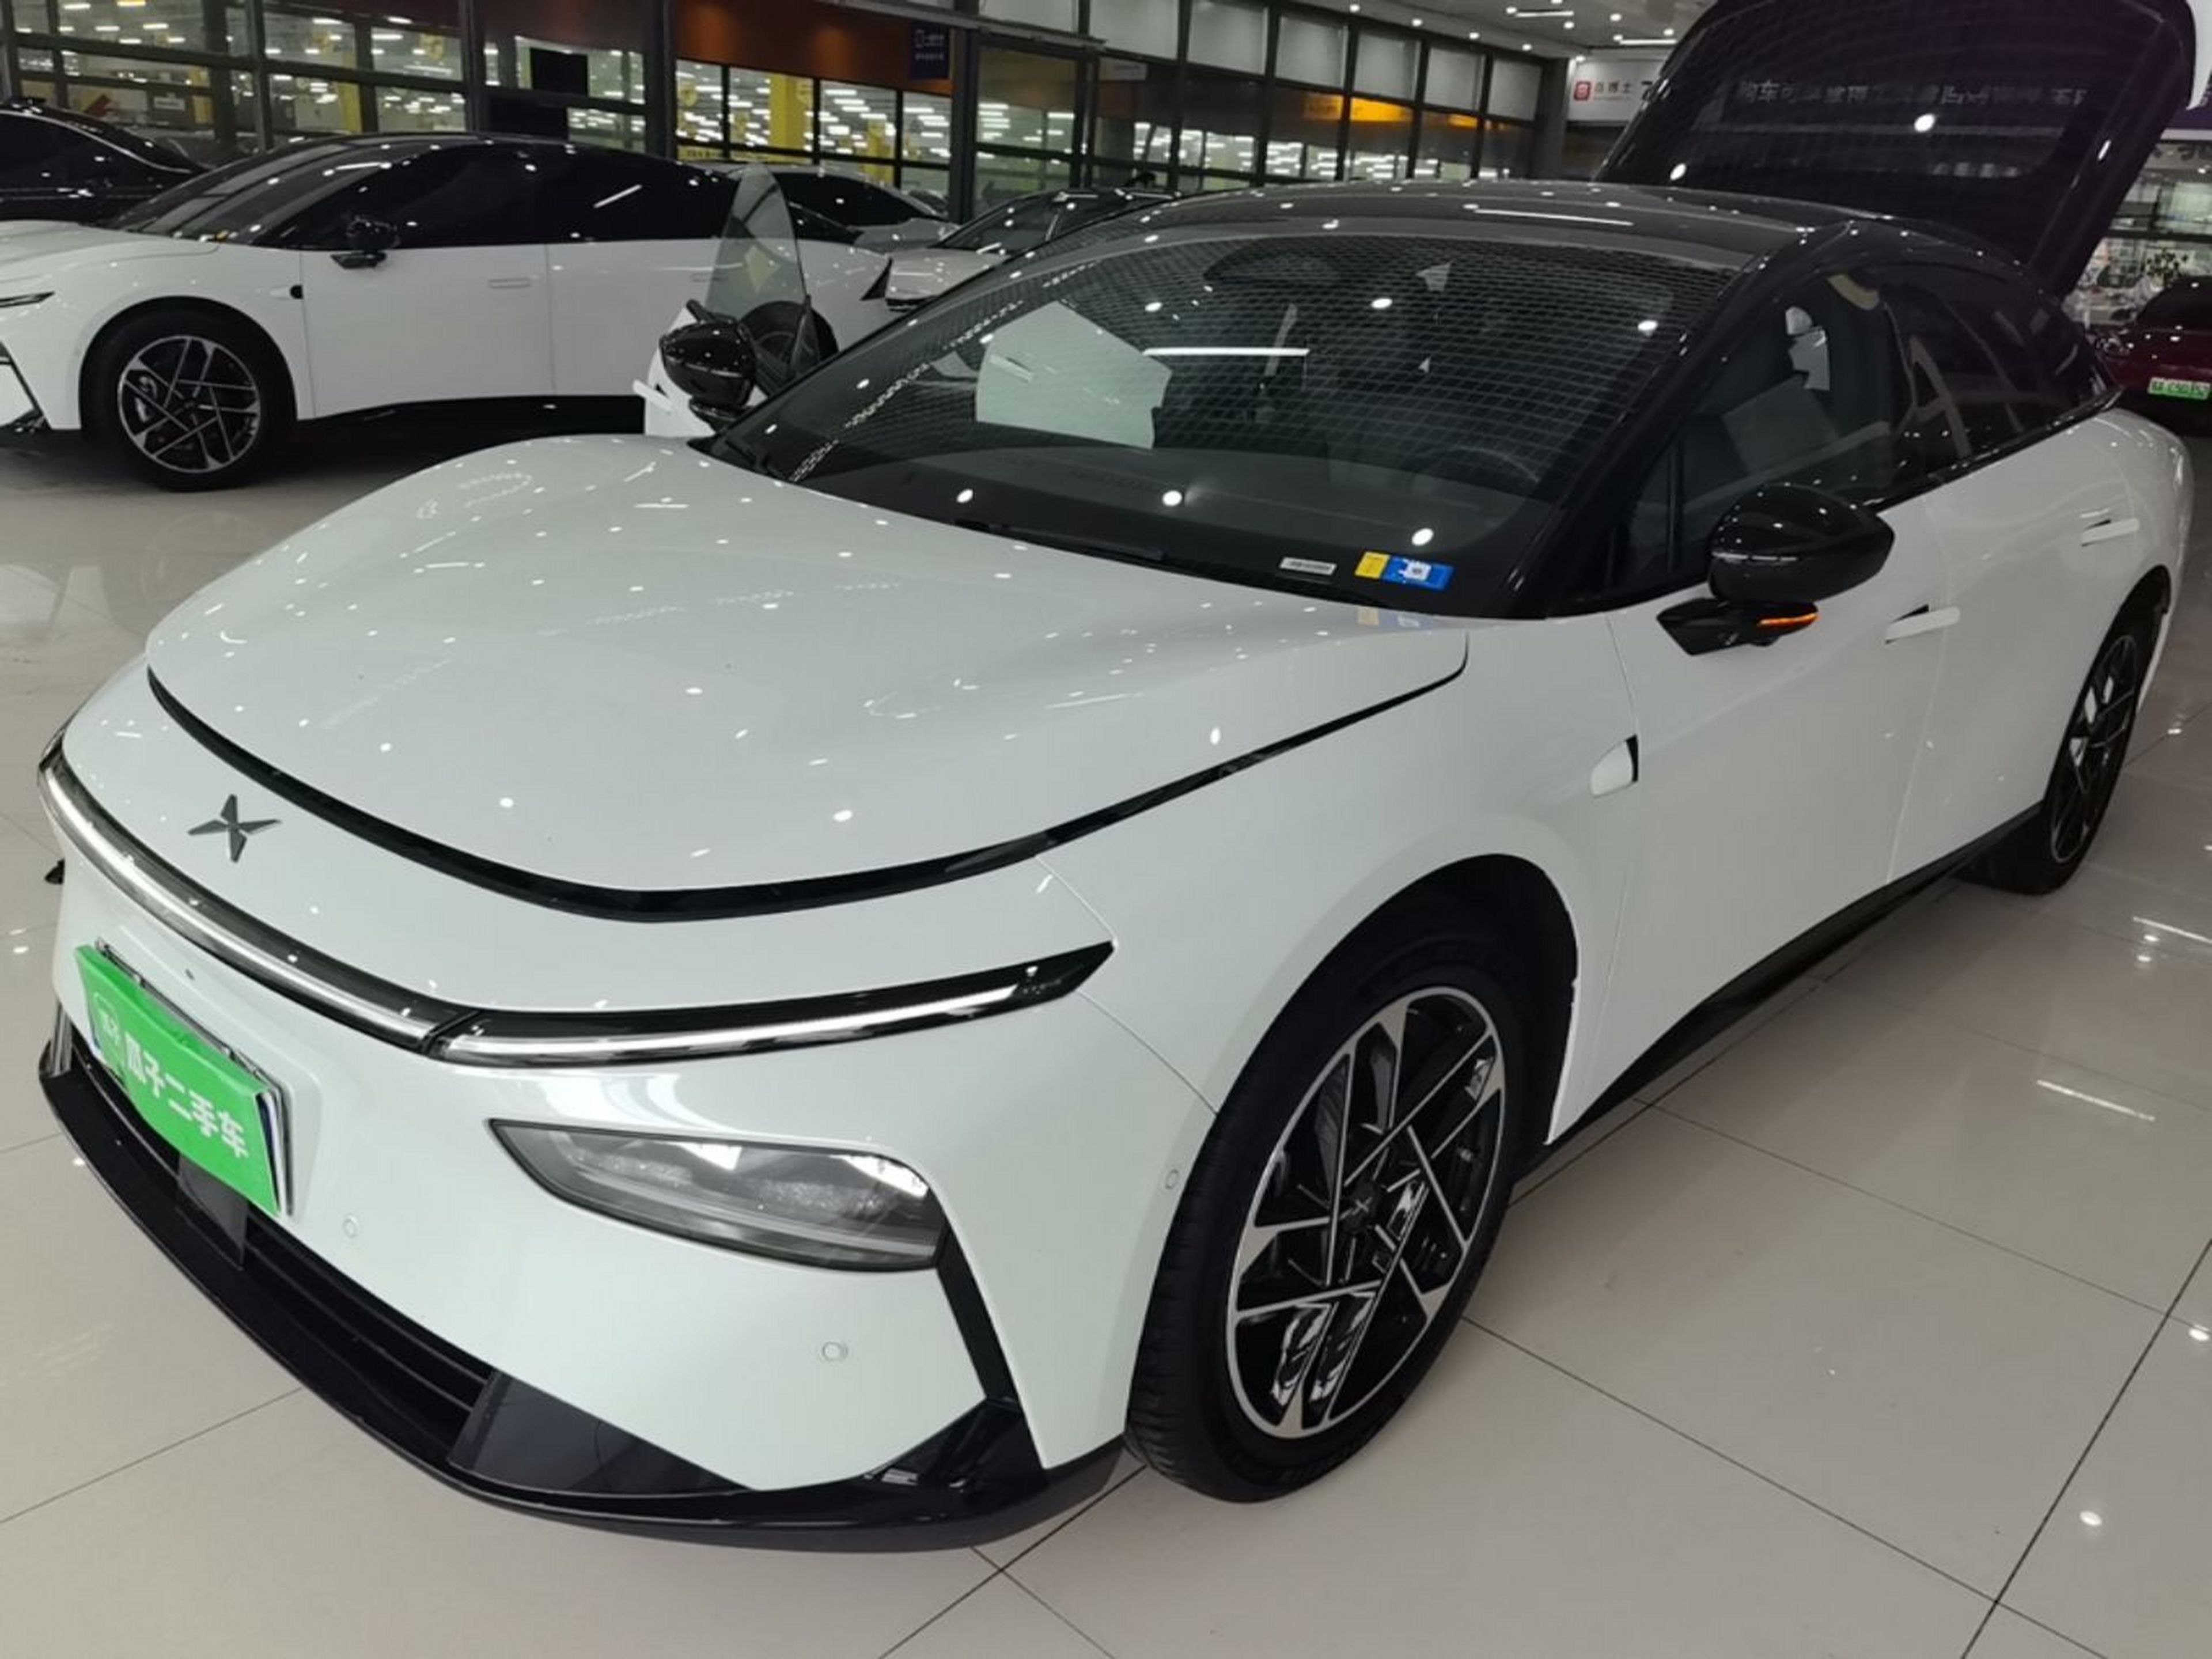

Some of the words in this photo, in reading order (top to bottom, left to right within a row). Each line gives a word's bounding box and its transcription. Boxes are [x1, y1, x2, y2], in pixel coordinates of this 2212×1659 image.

[126, 1032, 248, 1158] 瓜子二手车
